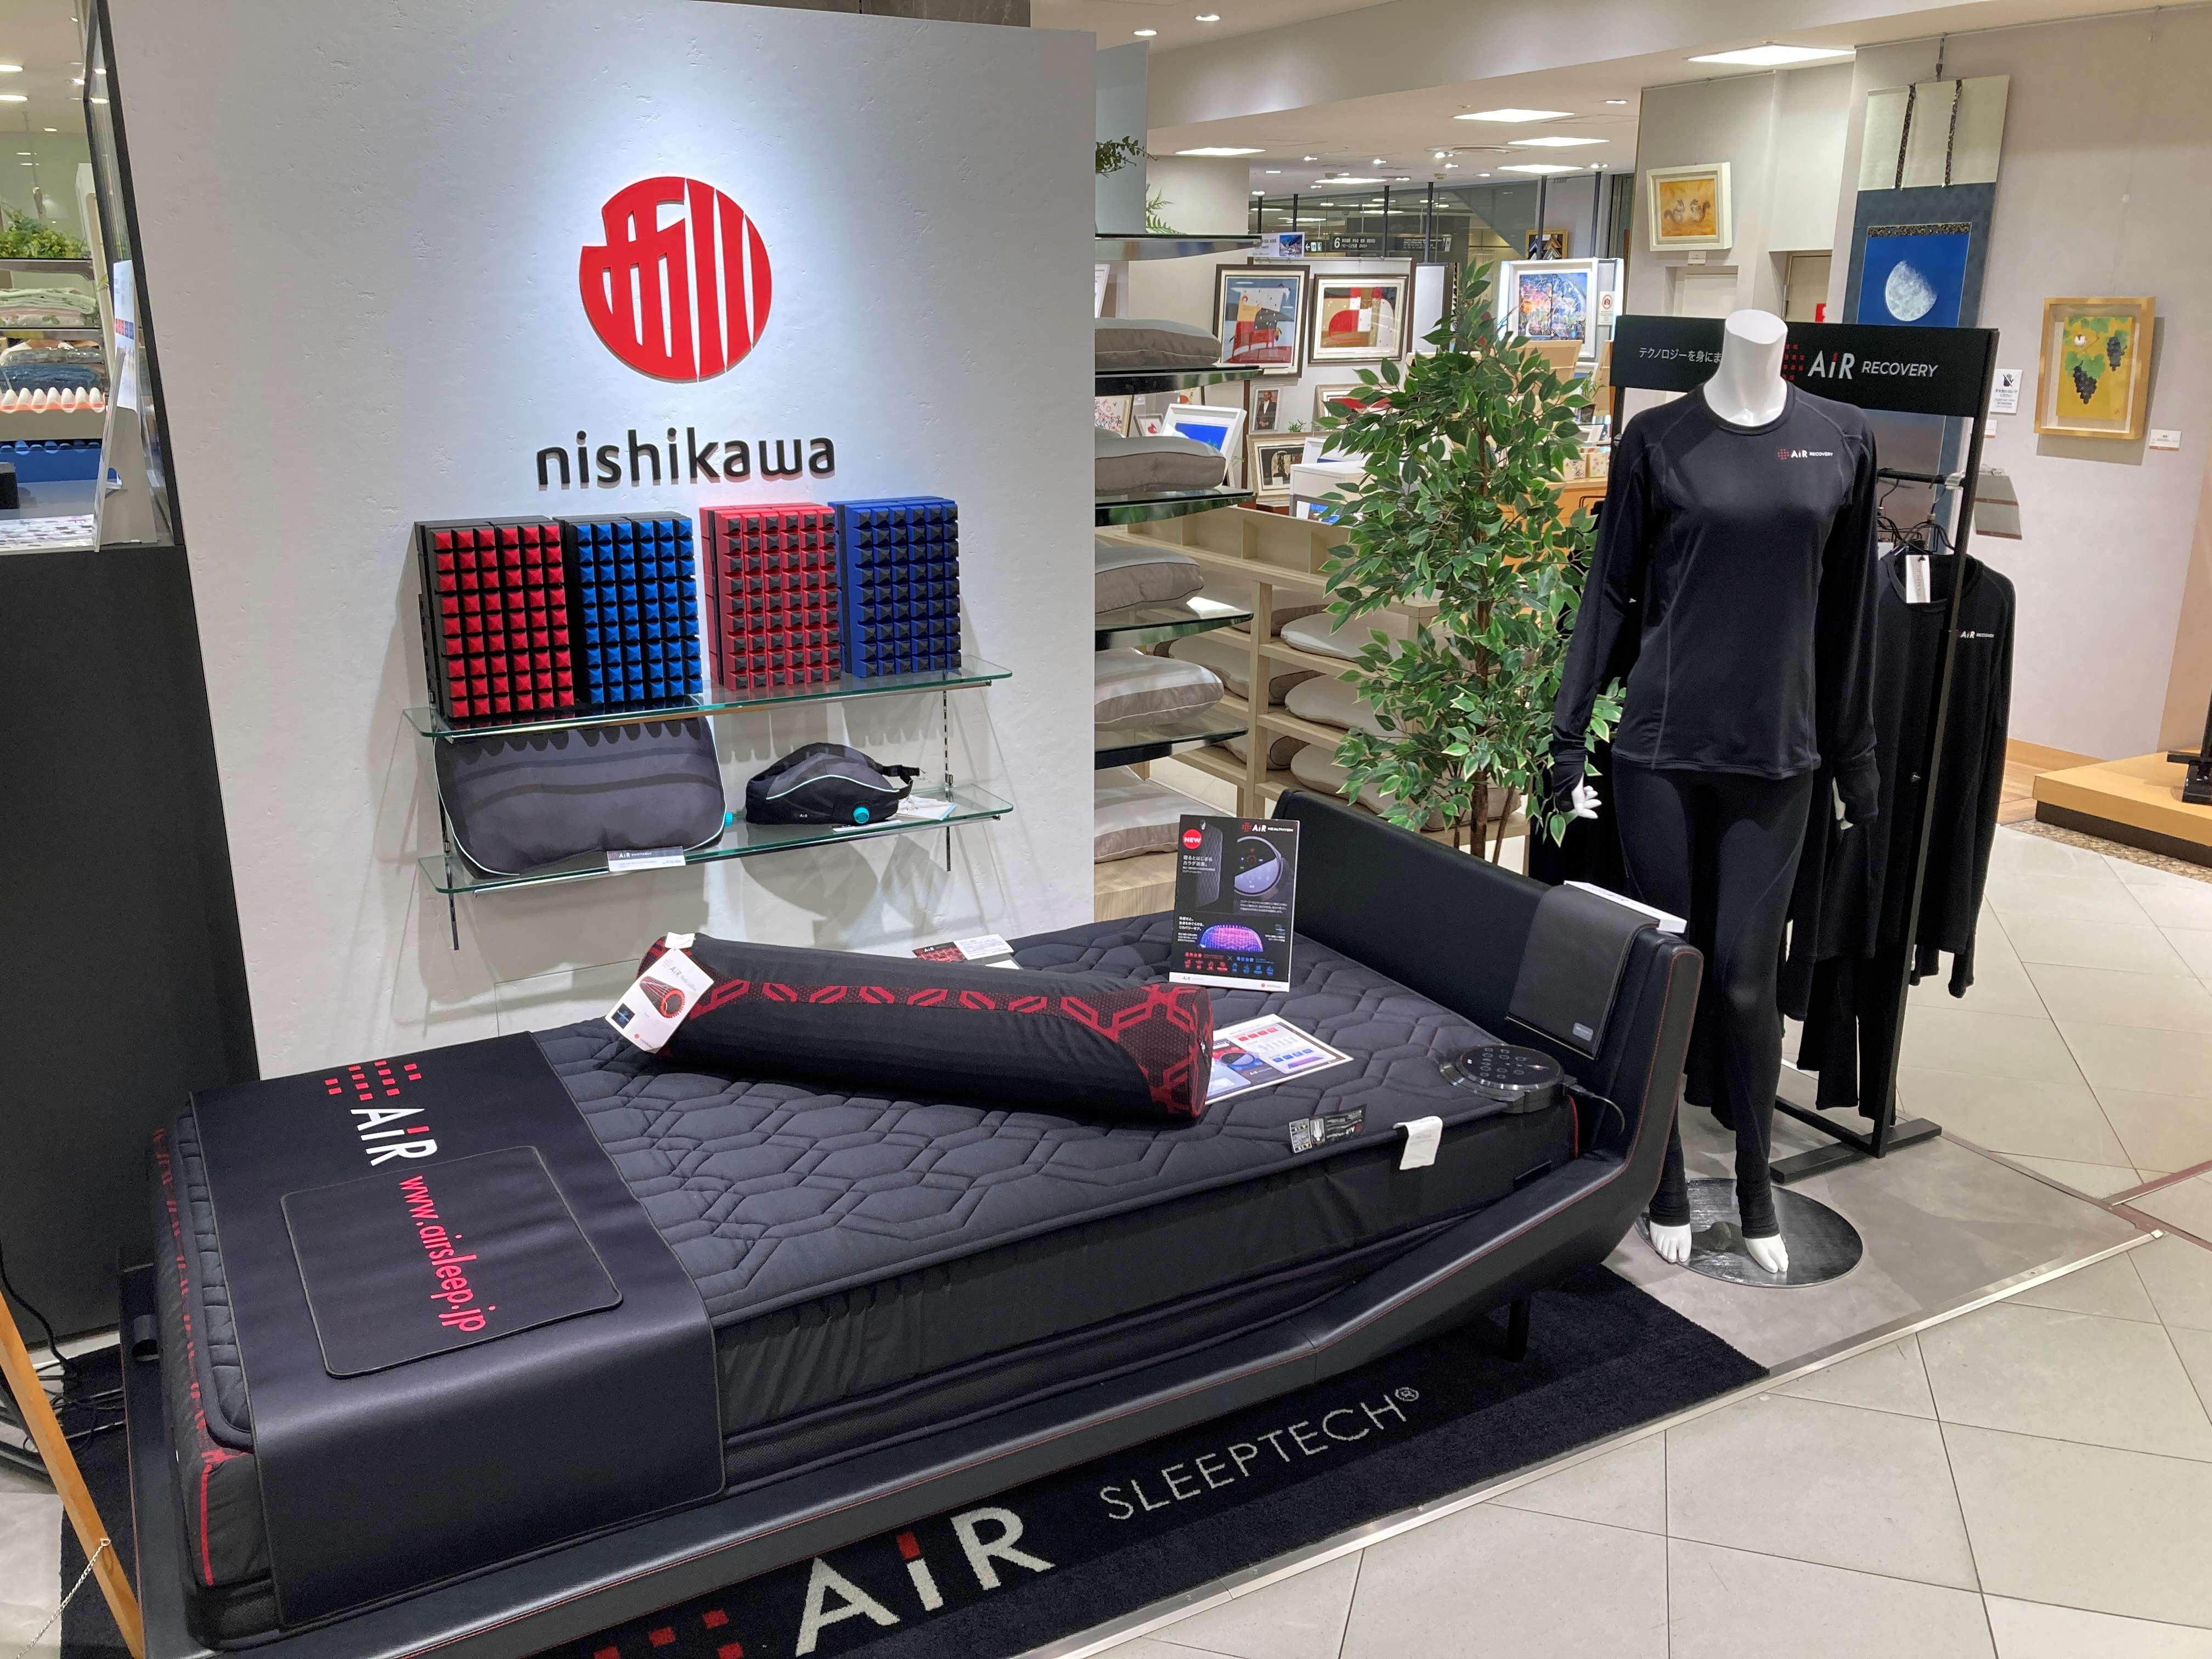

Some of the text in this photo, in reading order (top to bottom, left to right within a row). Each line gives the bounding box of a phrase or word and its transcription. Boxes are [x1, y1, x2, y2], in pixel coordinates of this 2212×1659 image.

[1334, 237, 1340, 249] 6
[1639, 347, 1722, 364] テクノロジーを身にま
[1807, 350, 1938, 380] AiR RECOVERY
[537, 427, 835, 486] nishikawa
[1791, 449, 1808, 458] AiR
[1252, 824, 1267, 832] AiR
[350, 1108, 438, 1166] AiR
[399, 1175, 496, 1333] www.airsleep.jp
[794, 1506, 1055, 1657] AiR
